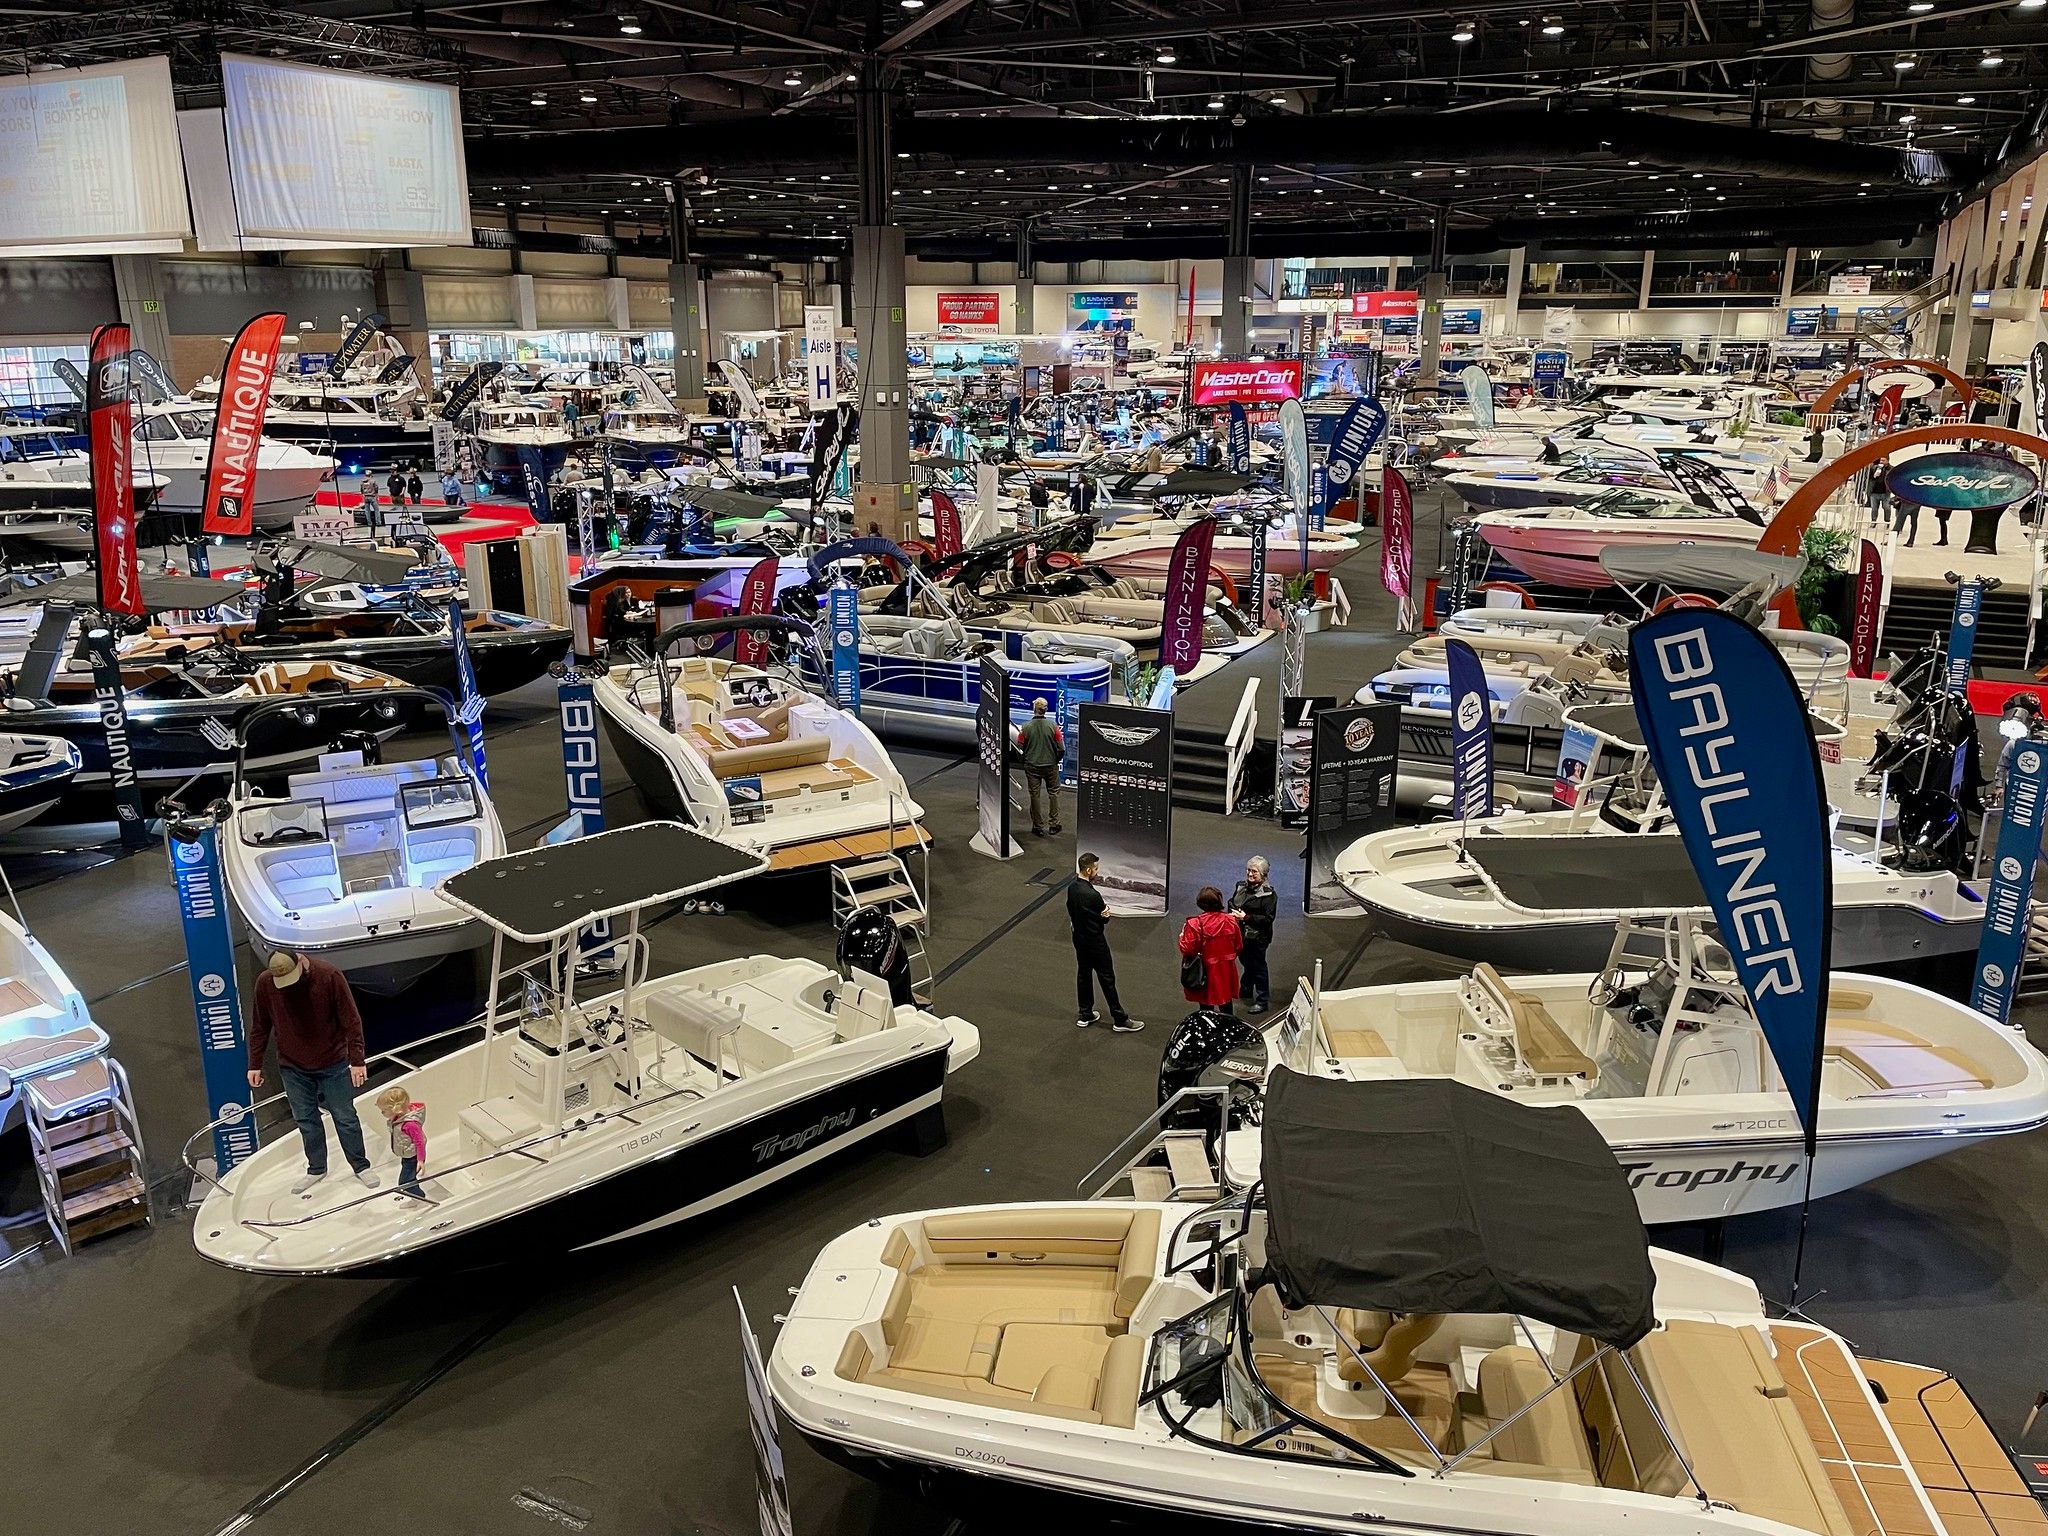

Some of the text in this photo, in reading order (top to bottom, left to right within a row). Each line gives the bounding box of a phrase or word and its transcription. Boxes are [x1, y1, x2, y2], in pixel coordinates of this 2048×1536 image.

[1729, 251, 1740, 262] M
[1810, 250, 1822, 260] W
[144, 301, 159, 312] 15P
[949, 311, 960, 320] GO
[334, 327, 371, 375] CUTWATER
[810, 338, 832, 354] Aisle
[1302, 314, 1313, 353] TADIUM
[815, 365, 831, 400] H
[1199, 369, 1296, 387] MasterCraft
[220, 348, 269, 494] NAUTIQUE
[1340, 403, 1378, 455] UNION
[523, 463, 539, 509] CREST
[1389, 488, 1402, 582] BENNINGTON
[836, 595, 851, 625] UNION
[1174, 546, 1199, 662] BENNINGTON
[1856, 562, 1875, 665] BENNINGTON
[837, 670, 852, 702] UNION
[1950, 658, 1967, 686] UNION
[95, 686, 135, 788] NAUTIQUE
[1354, 725, 1375, 741] YEAR
[1093, 755, 1154, 769] FLOORPLAN OPTIONS
[1321, 761, 1342, 770] LIFETIME
[1654, 628, 1802, 1002] BAYLINER
[2013, 782, 2039, 827] UNION
[179, 875, 193, 919] MARINE
[187, 871, 216, 919] UNION
[1994, 889, 2020, 936] UNION
[200, 1007, 213, 1051] MARINE
[207, 1004, 236, 1050] UNION
[1220, 1059, 1265, 1074] MERCURY
[618, 1128, 665, 1155] T18 BAY
[752, 1107, 857, 1164] Trophy
[1735, 1119, 1789, 1130] T20CC
[1619, 1160, 1800, 1193] Trophy
[1290, 1439, 1317, 1453] UNION
